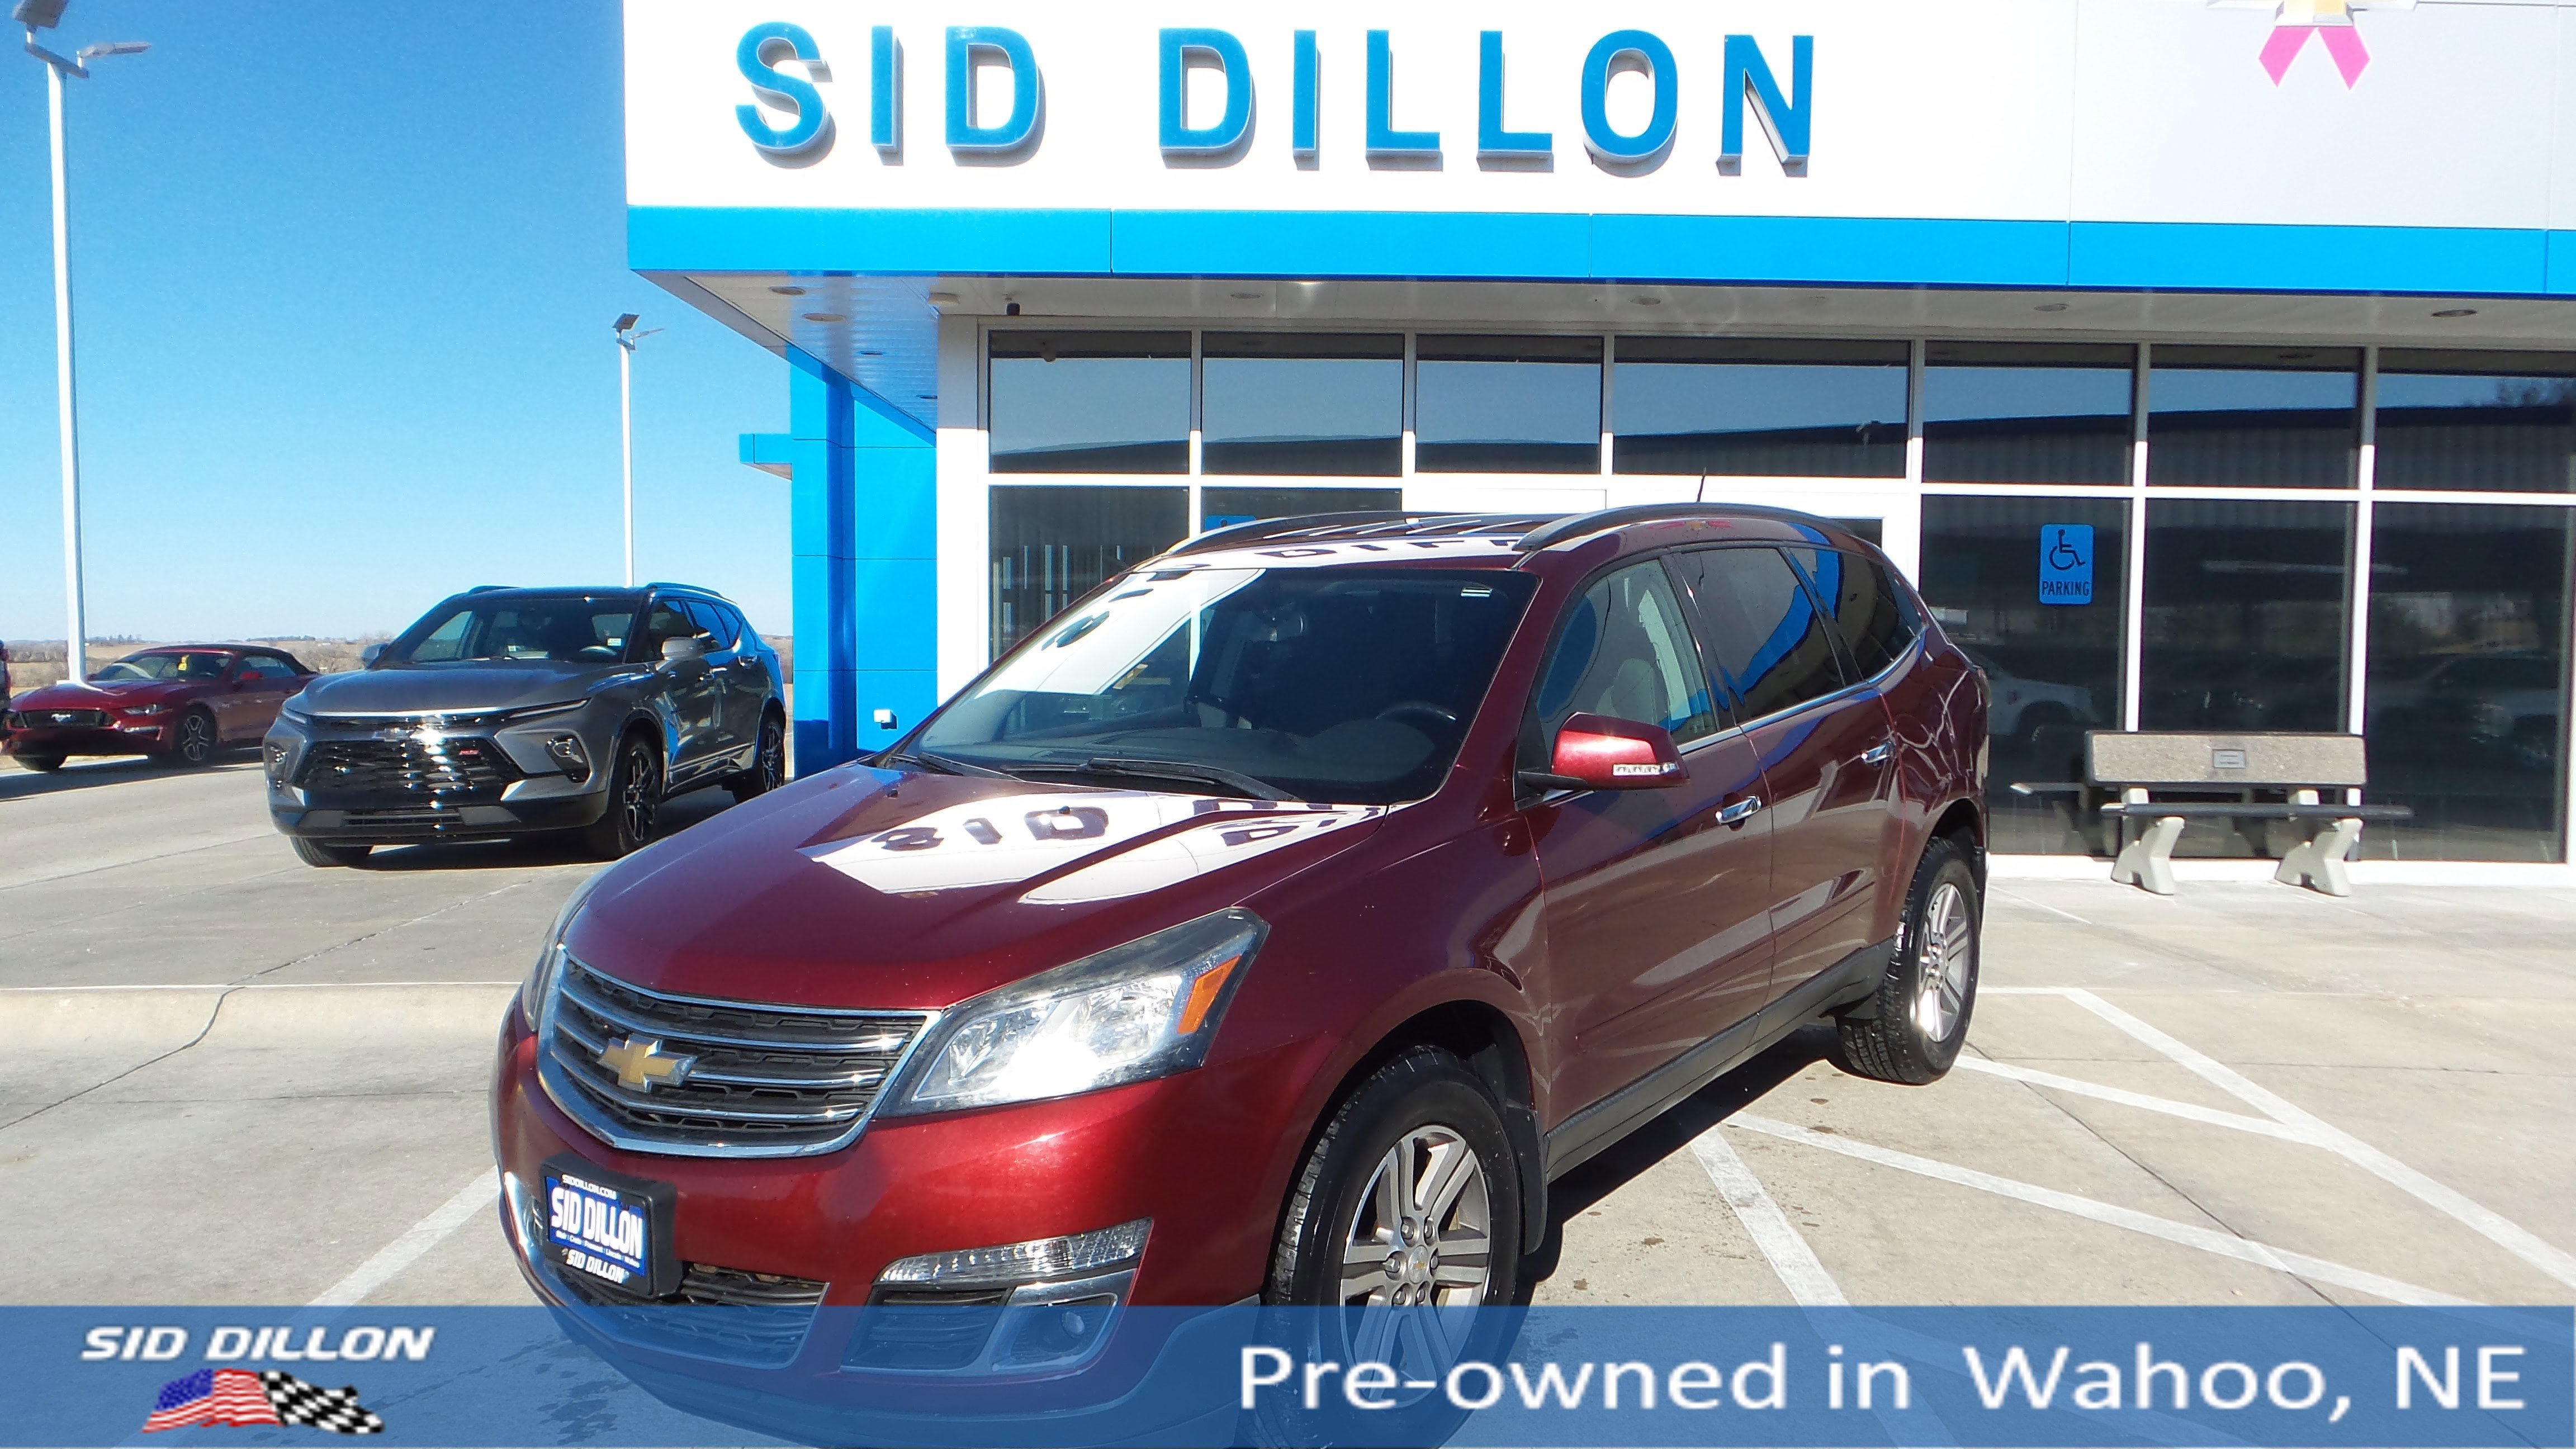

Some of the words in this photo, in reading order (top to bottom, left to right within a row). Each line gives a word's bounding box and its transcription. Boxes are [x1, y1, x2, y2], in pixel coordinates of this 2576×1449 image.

[736, 22, 1041, 157] SID
[1158, 28, 1815, 171] DILLON
[2042, 580, 2090, 596] PARKING
[561, 1174, 617, 1200] SIDDILLON.COM
[551, 1187, 581, 1234] SID
[583, 1196, 643, 1259] DILLON
[566, 1248, 586, 1268] SID
[585, 1256, 625, 1284] DILLON
